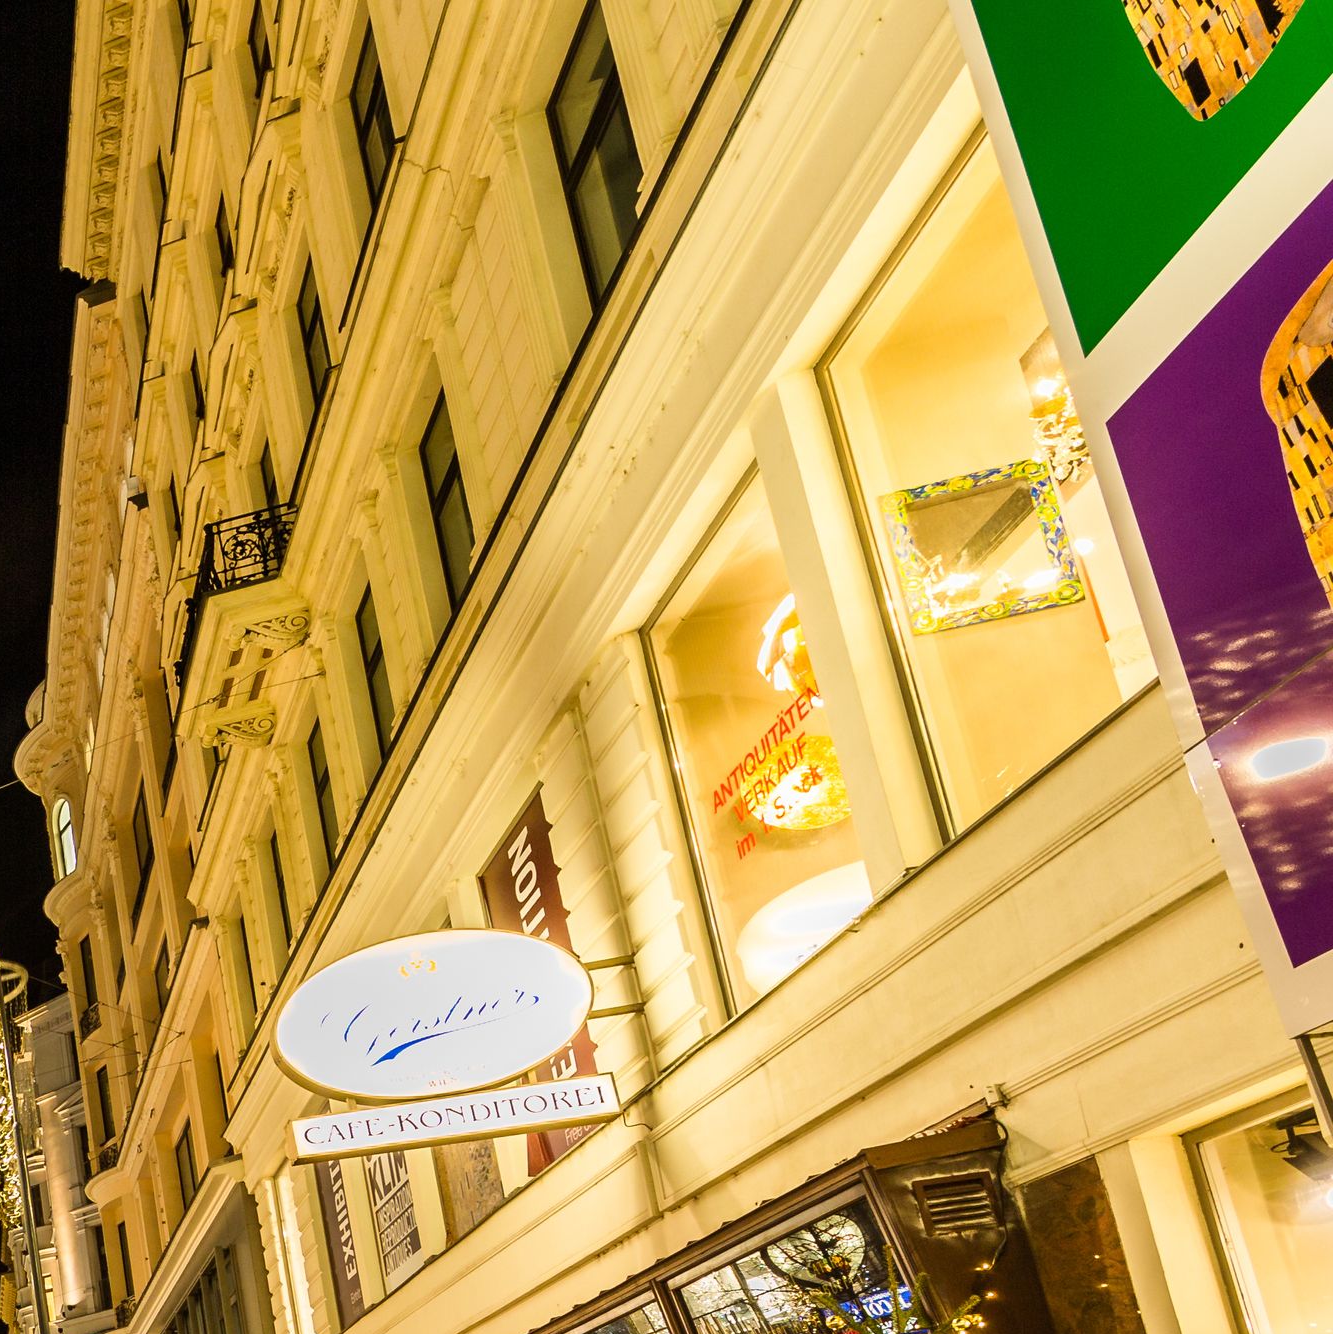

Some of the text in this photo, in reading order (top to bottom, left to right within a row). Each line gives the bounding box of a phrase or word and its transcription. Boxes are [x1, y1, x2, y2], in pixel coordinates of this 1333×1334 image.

[713, 680, 820, 813] ANTIQUITÄTEN
[734, 732, 807, 824] VERKAUF
[736, 831, 756, 860] im
